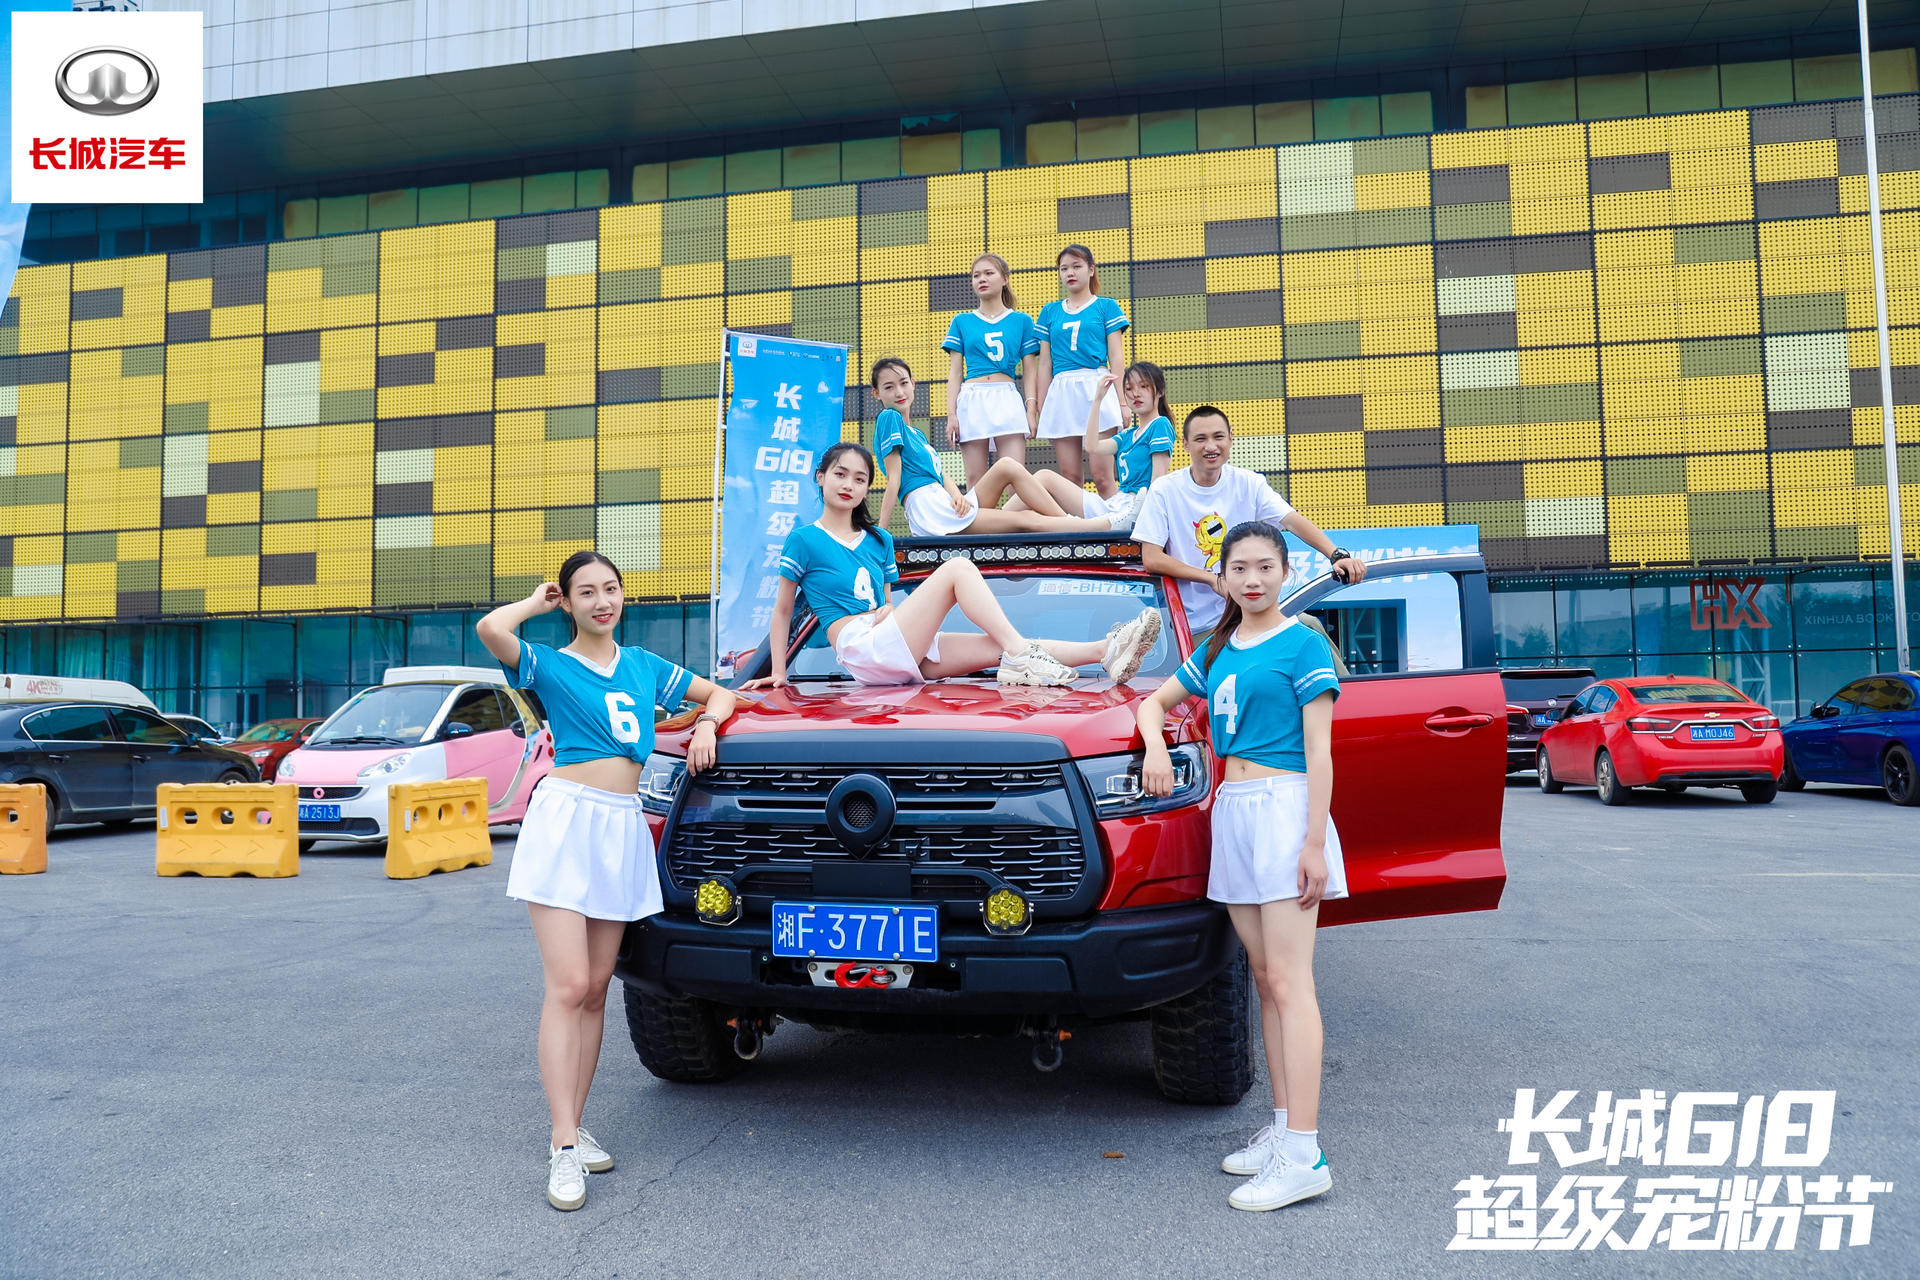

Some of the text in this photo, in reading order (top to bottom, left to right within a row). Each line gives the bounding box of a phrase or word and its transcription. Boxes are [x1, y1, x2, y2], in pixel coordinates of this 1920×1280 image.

[984, 331, 1005, 362] 5
[1062, 320, 1081, 351] 7
[853, 566, 877, 611] 4
[1689, 577, 1772, 630] HX
[1804, 615, 1854, 625] XINHUA
[604, 692, 641, 744] 6
[1213, 673, 1238, 735] 4
